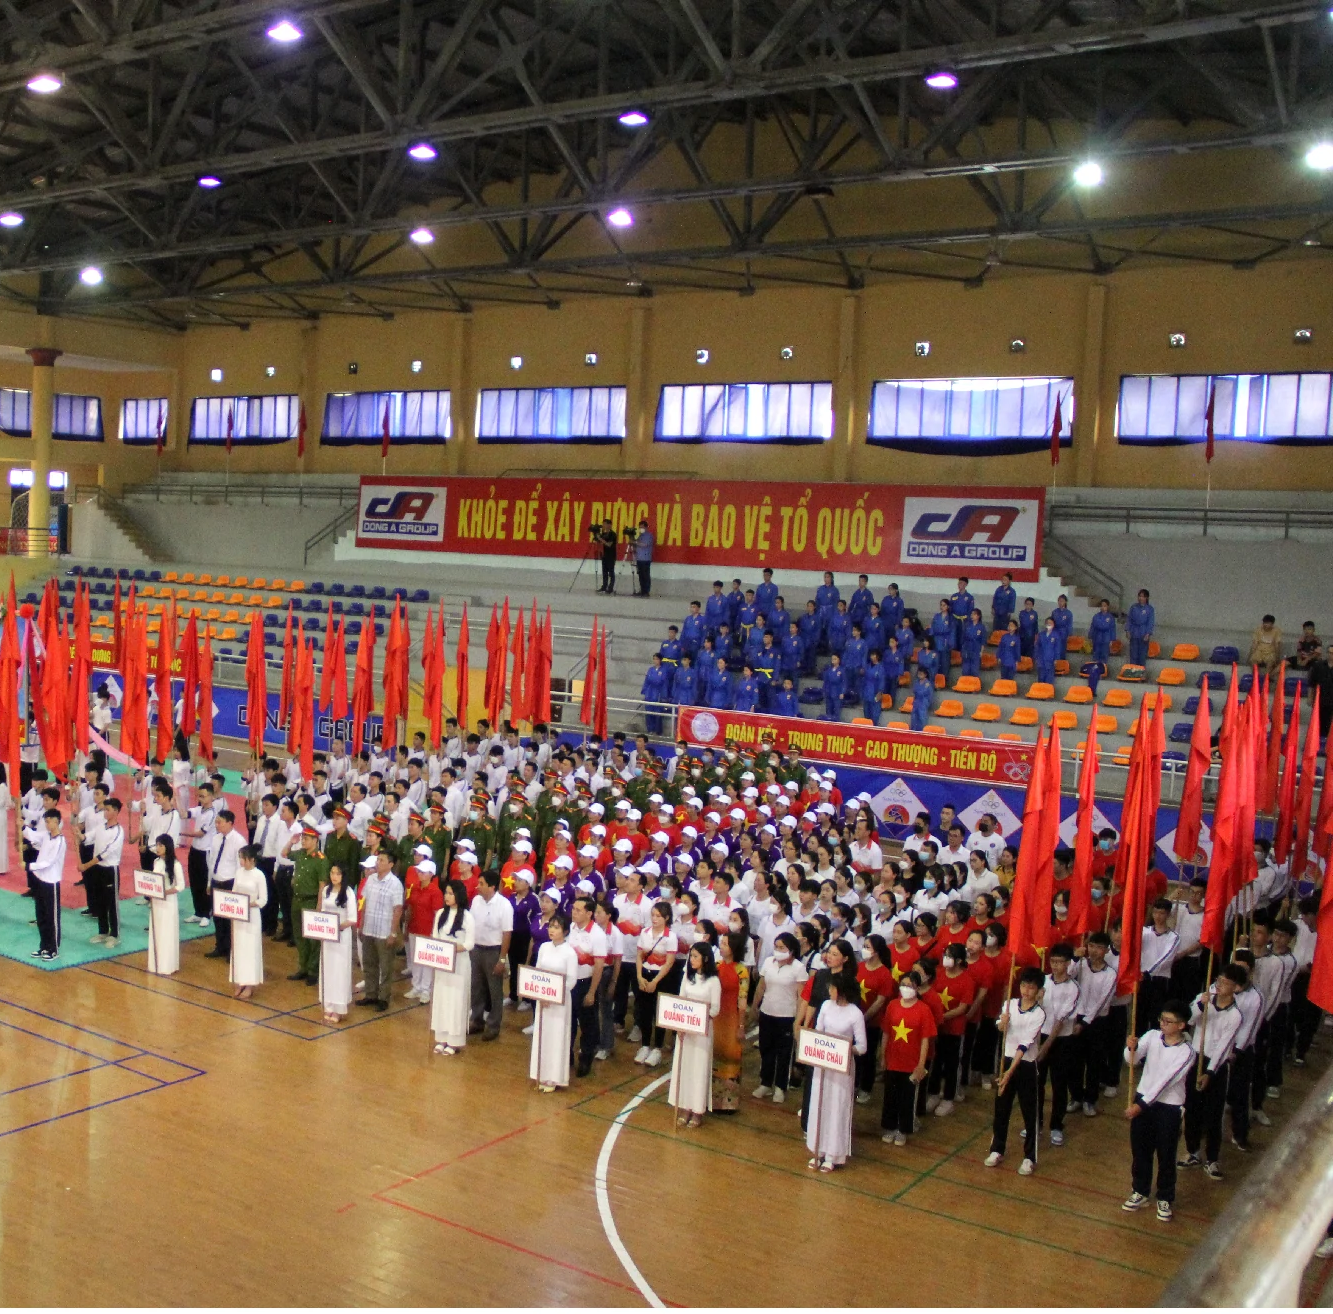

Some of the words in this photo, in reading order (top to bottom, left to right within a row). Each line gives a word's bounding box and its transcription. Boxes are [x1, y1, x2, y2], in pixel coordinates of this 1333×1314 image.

[363, 522, 389, 532] DONG
[390, 523, 397, 533] A
[399, 523, 437, 534] GROUP
[458, 485, 508, 539] KHỎE
[513, 483, 542, 541] ĐỂ
[544, 492, 585, 542] XÂY
[656, 493, 682, 546] VÀ
[690, 489, 736, 549] BẢO
[744, 496, 773, 560] VỆ
[780, 489, 812, 552] TỔ
[815, 492, 884, 559] QUỐC
[909, 543, 947, 556] DONG
[950, 546, 961, 556] A
[964, 546, 1025, 559] GROUP
[788, 730, 823, 751] TRUNG
[826, 734, 855, 759] THỰC
[865, 739, 889, 759] CAO
[892, 743, 939, 767] THƯỢNG
[950, 745, 977, 769] TIẾN
[979, 750, 997, 776] BỘ
